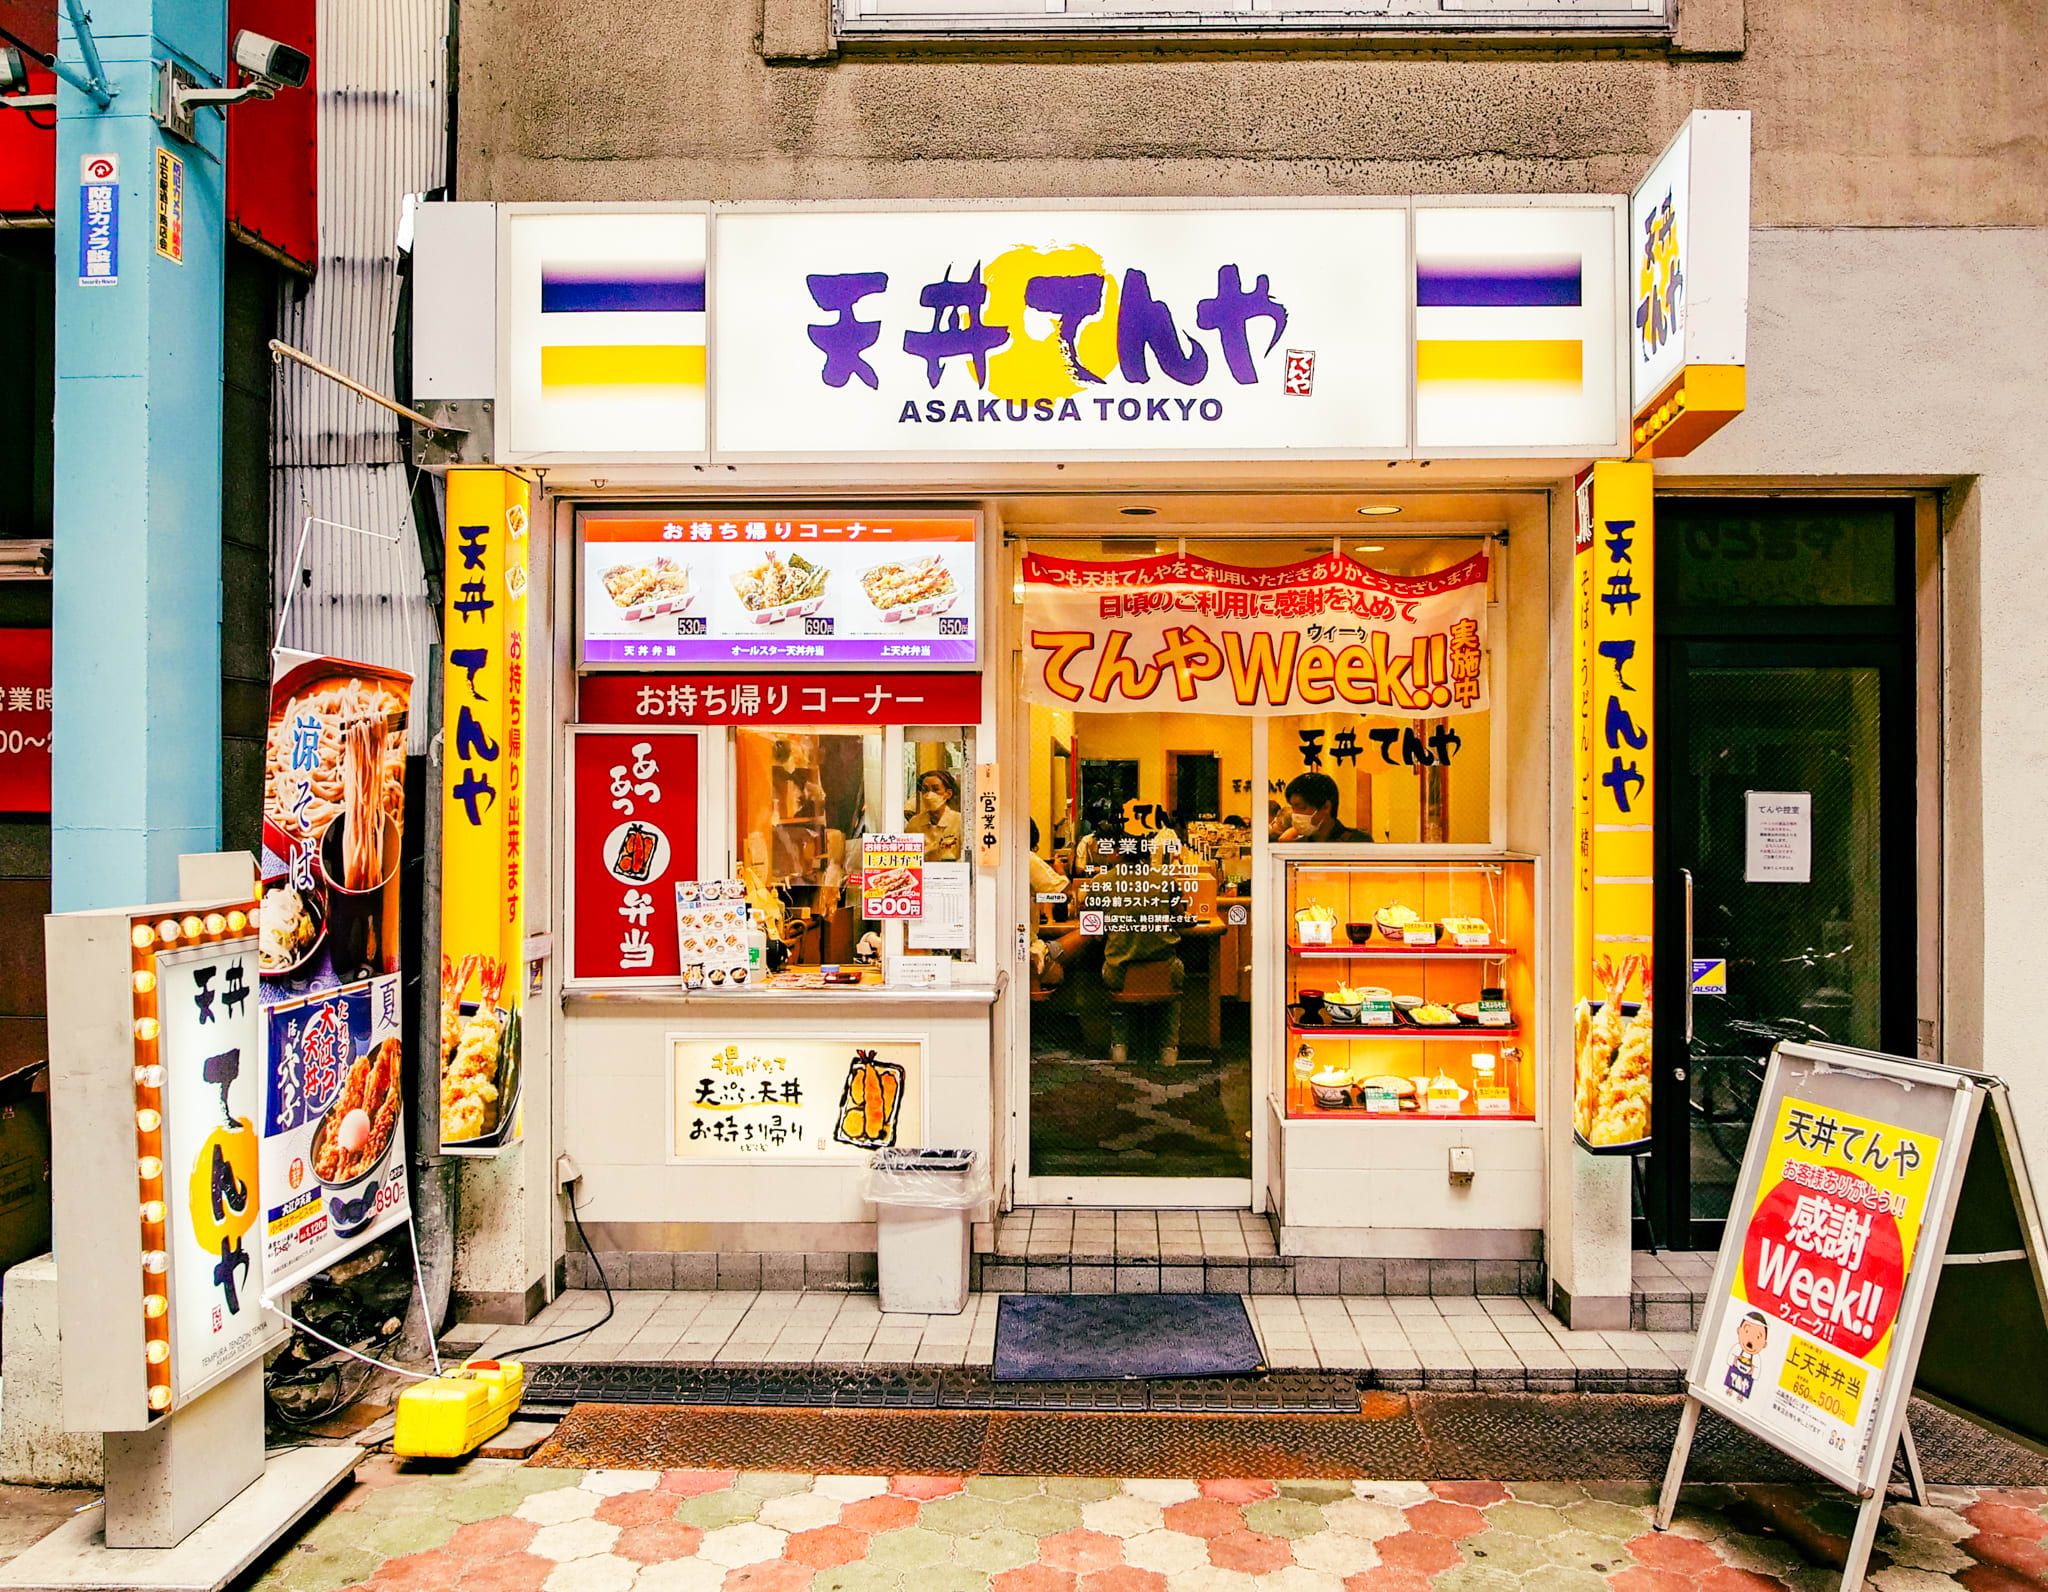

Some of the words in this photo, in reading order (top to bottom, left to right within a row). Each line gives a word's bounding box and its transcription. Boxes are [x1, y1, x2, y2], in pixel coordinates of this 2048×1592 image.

[806, 259, 1288, 390] 天丼てんや
[899, 398, 1081, 423] ASAKUSA
[1093, 398, 1223, 421] TOKYO
[664, 522, 893, 541] お持ち帰りコーナー
[1099, 586, 1421, 622] 日頃のご利用に感謝を込めて
[450, 525, 499, 826] 天丼てんや
[624, 645, 676, 657] 天丼弁当
[731, 645, 824, 657] オールスター天丼弁当
[880, 645, 930, 657] 上天丼弁当
[1450, 618, 1481, 708] 実施中
[1598, 520, 1648, 813] 天丼てんや
[635, 684, 924, 717] お持ち帰りコーナー
[1298, 725, 1461, 767] 天丼てんや
[508, 630, 522, 923] お持ち帰り出来ます
[980, 791, 997, 849] 営業中
[868, 855, 922, 867] 上天丼弁当
[1085, 865, 1108, 875] 平日
[1097, 838, 1181, 856] 営業時間
[618, 889, 655, 969] 弁当
[867, 898, 921, 915] 500円
[1104, 924, 1173, 932] いただいております。
[377, 978, 399, 1030] 夏
[302, 1029, 321, 1097] 天丼
[319, 1002, 336, 1102] 大江戸
[1784, 1109, 1921, 1178] 天丼てんや
[1782, 1159, 1908, 1218] お客様ありがとう!!
[1785, 1194, 1872, 1272] 感謝
[1756, 1237, 1885, 1340] Week!!
[1785, 1347, 1861, 1400] 上天丼弁当
